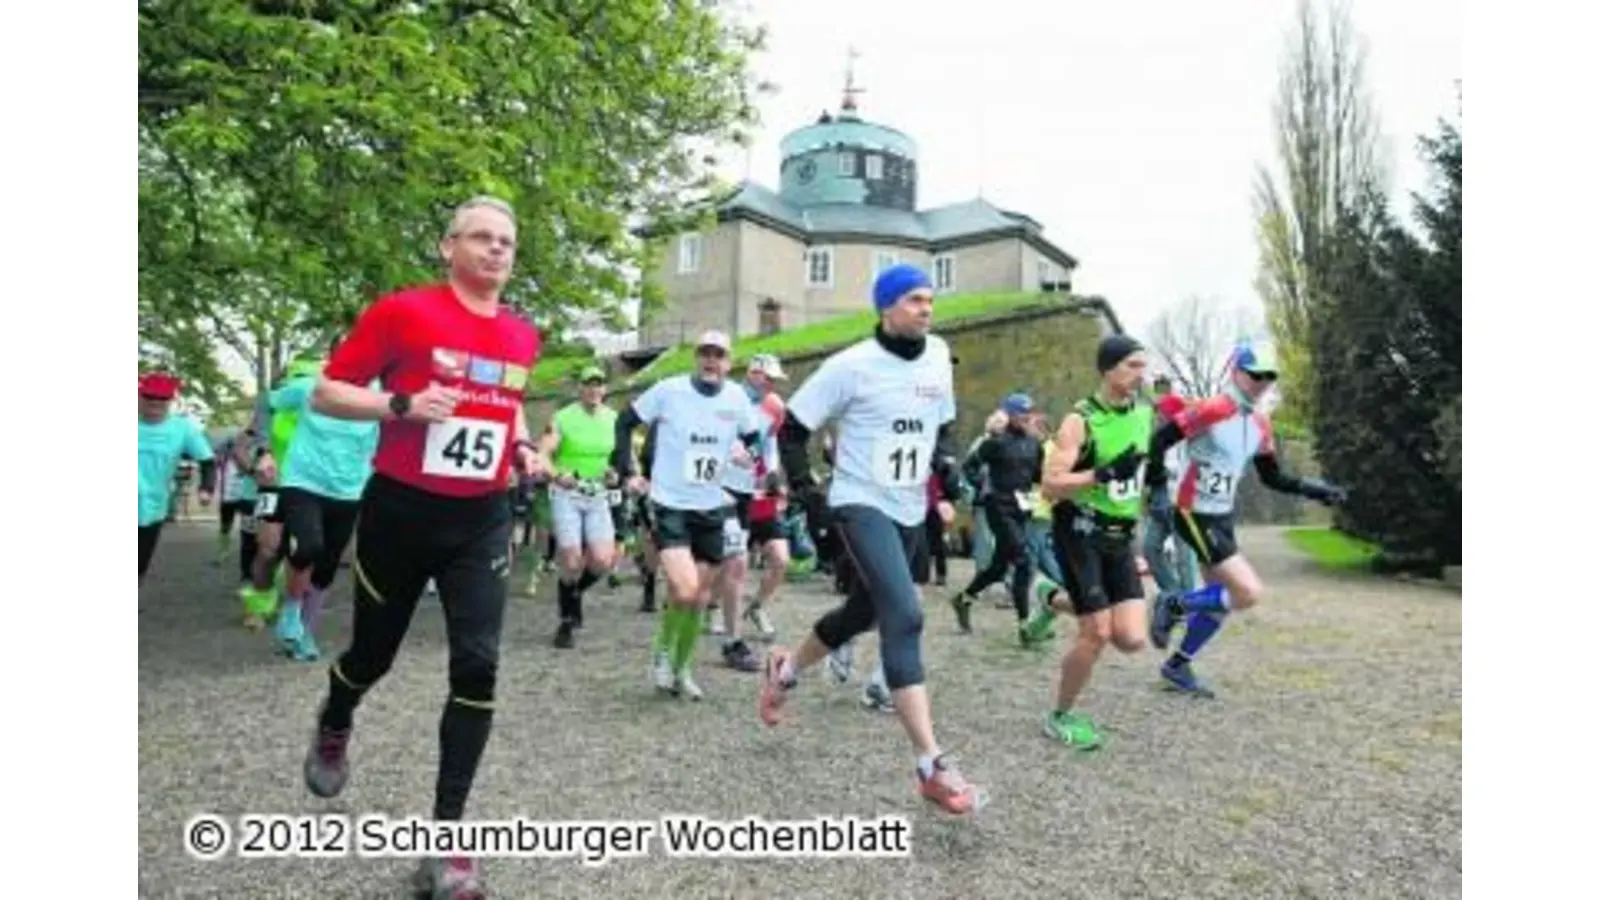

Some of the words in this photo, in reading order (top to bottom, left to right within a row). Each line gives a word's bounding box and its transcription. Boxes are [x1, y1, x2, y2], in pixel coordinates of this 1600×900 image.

[442, 426, 495, 471] 45
[694, 456, 718, 481] 18
[888, 448, 917, 481] 11
[1209, 472, 1232, 495] 21
